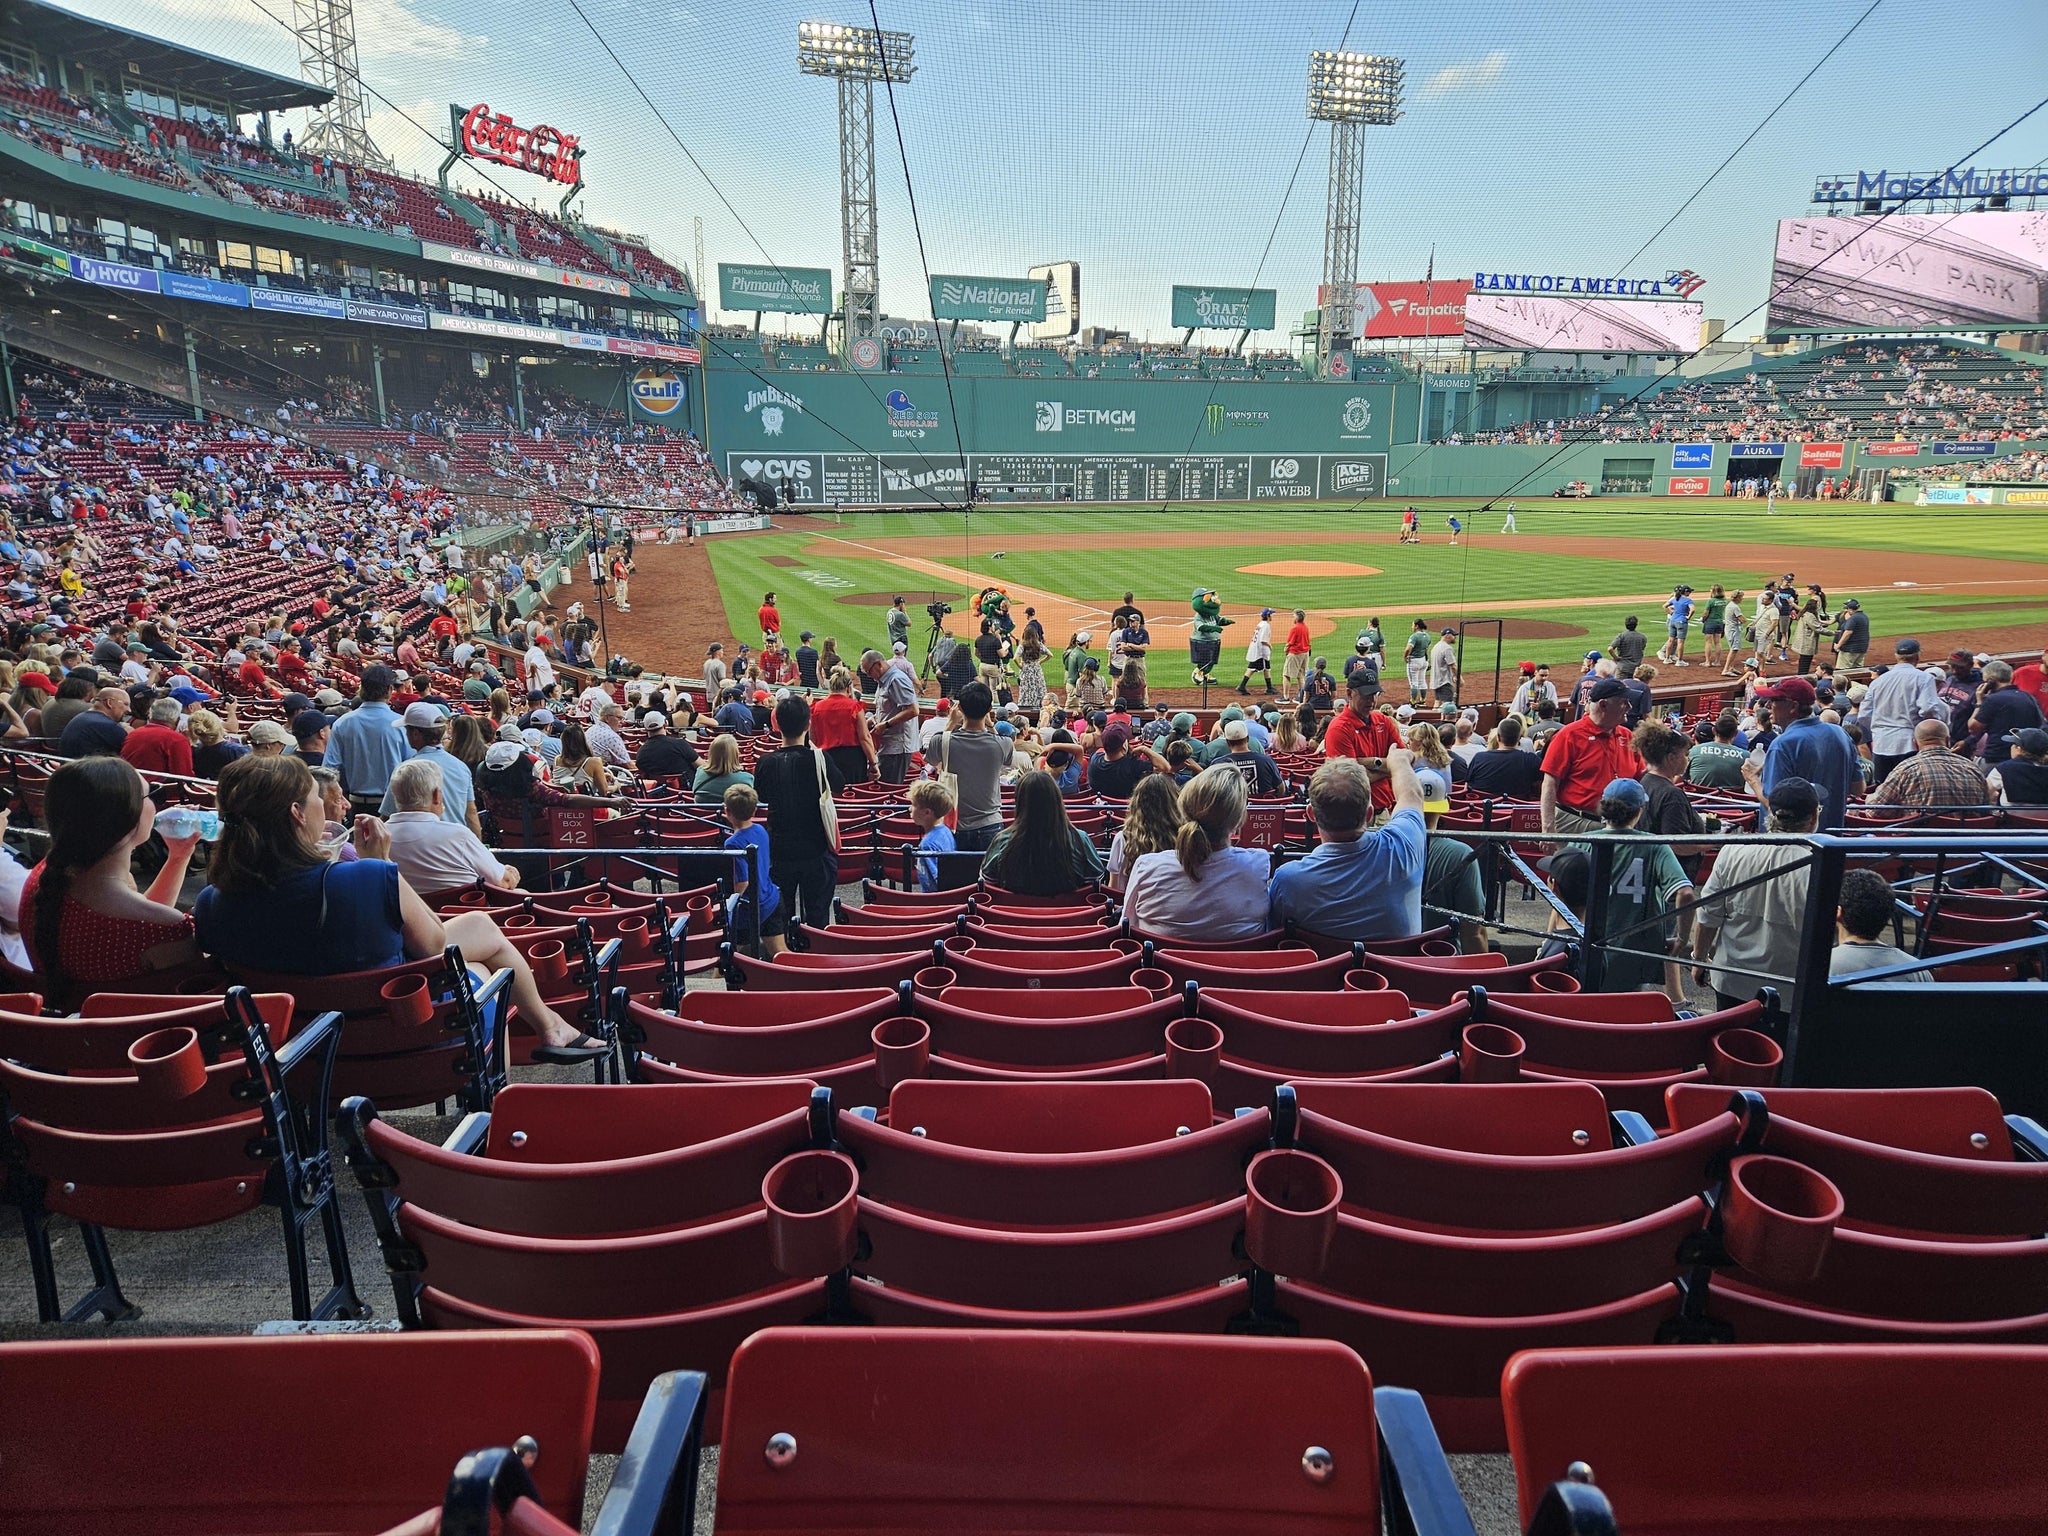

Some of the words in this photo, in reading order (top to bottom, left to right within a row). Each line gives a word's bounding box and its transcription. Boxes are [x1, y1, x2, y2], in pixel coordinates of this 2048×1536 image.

[450, 251, 482, 266] WELCOME
[483, 258, 493, 267] TO
[494, 260, 520, 272] FENWAY
[521, 265, 538, 276] PARK
[1789, 223, 1923, 275] FENWAY
[1947, 265, 2016, 301] PARK
[99, 265, 139, 285] HYCU
[732, 276, 788, 292] Plymouth
[790, 279, 820, 294] Rock
[1475, 272, 1534, 291] BANK
[1539, 275, 1565, 292] OF
[1570, 277, 1662, 295] AMERICA
[253, 290, 292, 303] COGHLIN
[293, 296, 342, 309] COMPANIES
[963, 285, 1036, 305] National
[356, 306, 398, 320] VINEYARD
[399, 313, 424, 323] VINES
[988, 305, 1003, 314] Car
[1005, 306, 1033, 315] Rental
[1196, 300, 1249, 316] DRAFT
[1409, 303, 1466, 316] Fanatics
[1203, 315, 1247, 326] KINGS
[1478, 297, 1584, 342] ENWAY
[441, 318, 477, 330] AMERICA'S
[478, 322, 496, 333] MOST
[497, 325, 525, 337] BELOVED
[526, 329, 557, 341] BALLPARK
[633, 381, 680, 398] Gulf
[1432, 377, 1470, 388] ABIOMED
[743, 391, 768, 413] JIM
[766, 385, 804, 414] BEAM
[892, 411, 913, 420] RED
[916, 411, 939, 420] SOX
[1065, 410, 1136, 425] BETMGM
[1226, 410, 1270, 420] MONSTER
[892, 419, 939, 428] SCHOLARS
[1803, 451, 1842, 459] Safelite
[1888, 445, 1918, 454] TICKET
[764, 459, 812, 479] CVS
[1270, 458, 1299, 478] 160
[1339, 464, 1370, 477] ACE
[913, 468, 967, 488] MASON
[1339, 475, 1370, 486] TICKET
[1256, 486, 1276, 497] F.W.
[1278, 486, 1311, 497] WEBB
[1675, 482, 1704, 490] IRVING
[1927, 490, 1960, 500] etBlue
[1314, 680, 1330, 695] 13
[578, 699, 592, 712] 48
[1700, 746, 1720, 755] RED
[1723, 749, 1743, 759] SOX
[1861, 763, 1872, 773] OX
[1423, 784, 1433, 797] B
[560, 831, 588, 844] 42
[1251, 833, 1271, 845] 41
[1616, 858, 1646, 904] 4
[252, 1034, 266, 1060] EE
